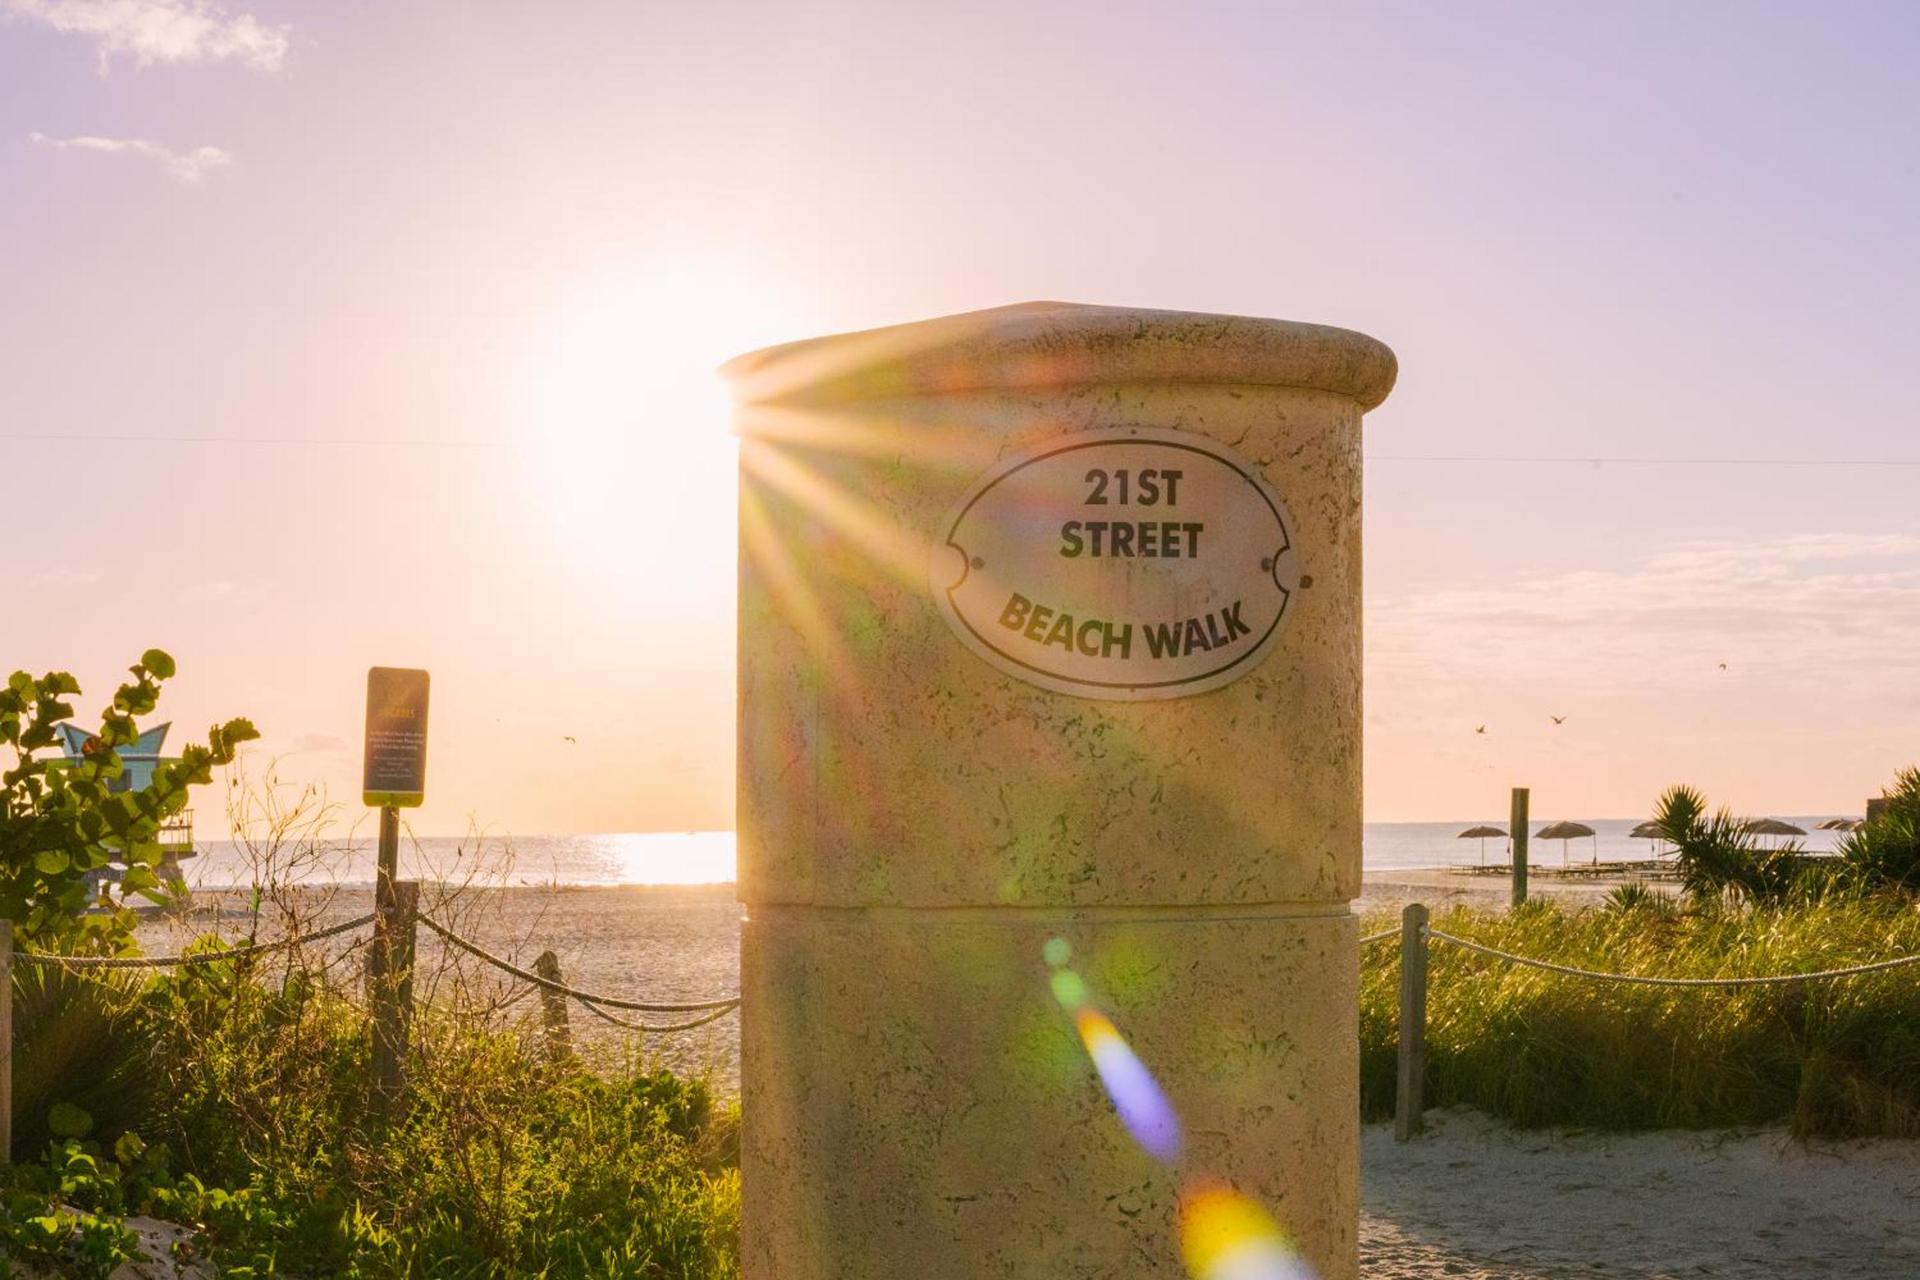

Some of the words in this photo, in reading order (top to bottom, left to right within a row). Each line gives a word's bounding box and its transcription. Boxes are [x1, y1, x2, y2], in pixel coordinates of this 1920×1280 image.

[1084, 469, 1183, 506] 21ST
[1060, 521, 1204, 558] STREET
[998, 592, 1133, 660] BEACH
[1143, 600, 1251, 659] WALK
